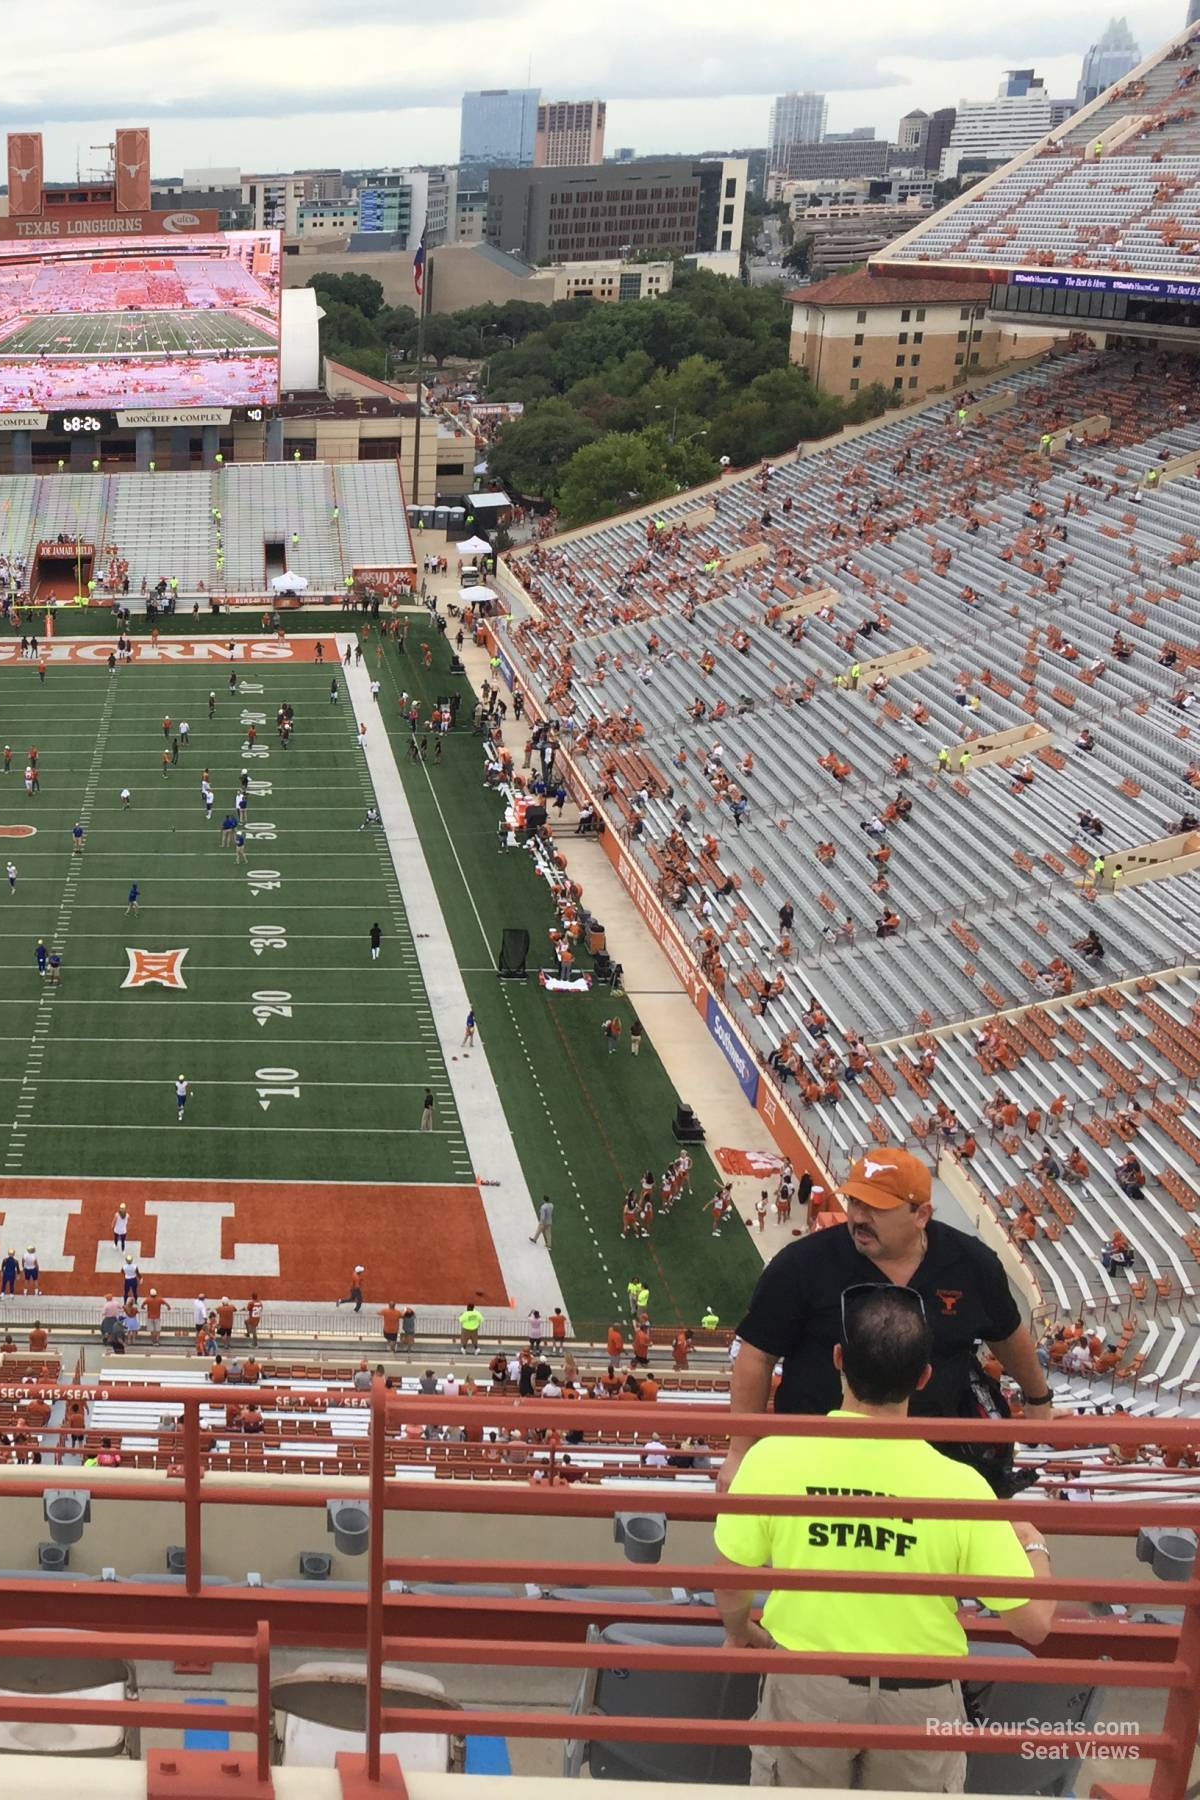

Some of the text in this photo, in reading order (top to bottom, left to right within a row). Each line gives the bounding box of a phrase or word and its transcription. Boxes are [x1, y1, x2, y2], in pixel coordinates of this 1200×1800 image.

[16, 218, 143, 236] TEXAS LONGHORNS
[125, 413, 222, 423] MONCRIEF COMPLEX
[247, 409, 262, 421] 40
[40, 545, 51, 556] JOE
[247, 869, 281, 890] 40
[249, 925, 287, 949] 30
[252, 990, 292, 1018] 20
[714, 1015, 746, 1079] Southwest
[255, 1067, 300, 1099] 10
[0, 1388, 109, 1400] SECT. 115/SEAT 9
[808, 1522, 917, 1557] STAFF
